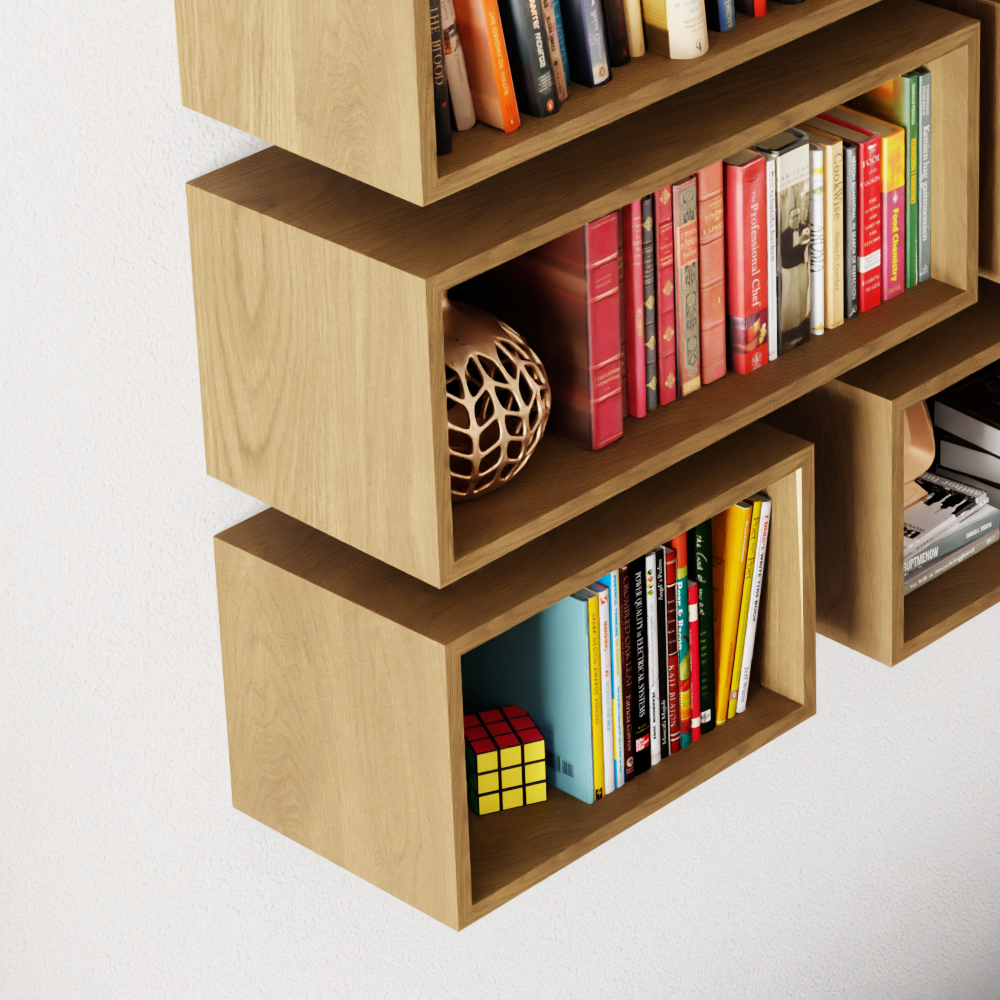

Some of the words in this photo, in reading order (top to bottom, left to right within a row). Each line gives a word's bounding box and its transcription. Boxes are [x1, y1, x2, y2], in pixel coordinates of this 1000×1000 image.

[921, 125, 930, 161] Kemien
[832, 153, 843, 221] CookWise
[920, 162, 930, 178] bag
[891, 208, 899, 232] Food
[920, 180, 930, 241] gastronomien
[750, 203, 761, 276] Professional
[890, 234, 899, 281] Chemistry
[751, 278, 761, 308] Chef
[750, 516, 760, 541] Poet
[745, 556, 755, 580] Poet
[918, 575, 928, 584] kill
[935, 548, 975, 575] mockingbird
[634, 571, 643, 597] POWER
[622, 575, 631, 635] CRUMBLED
[634, 597, 644, 630] QUALITY
[636, 638, 644, 684] ELECTRICAL
[668, 664, 676, 690] KATE
[637, 684, 645, 718] SYSTEMS
[669, 691, 677, 728] BEATON
